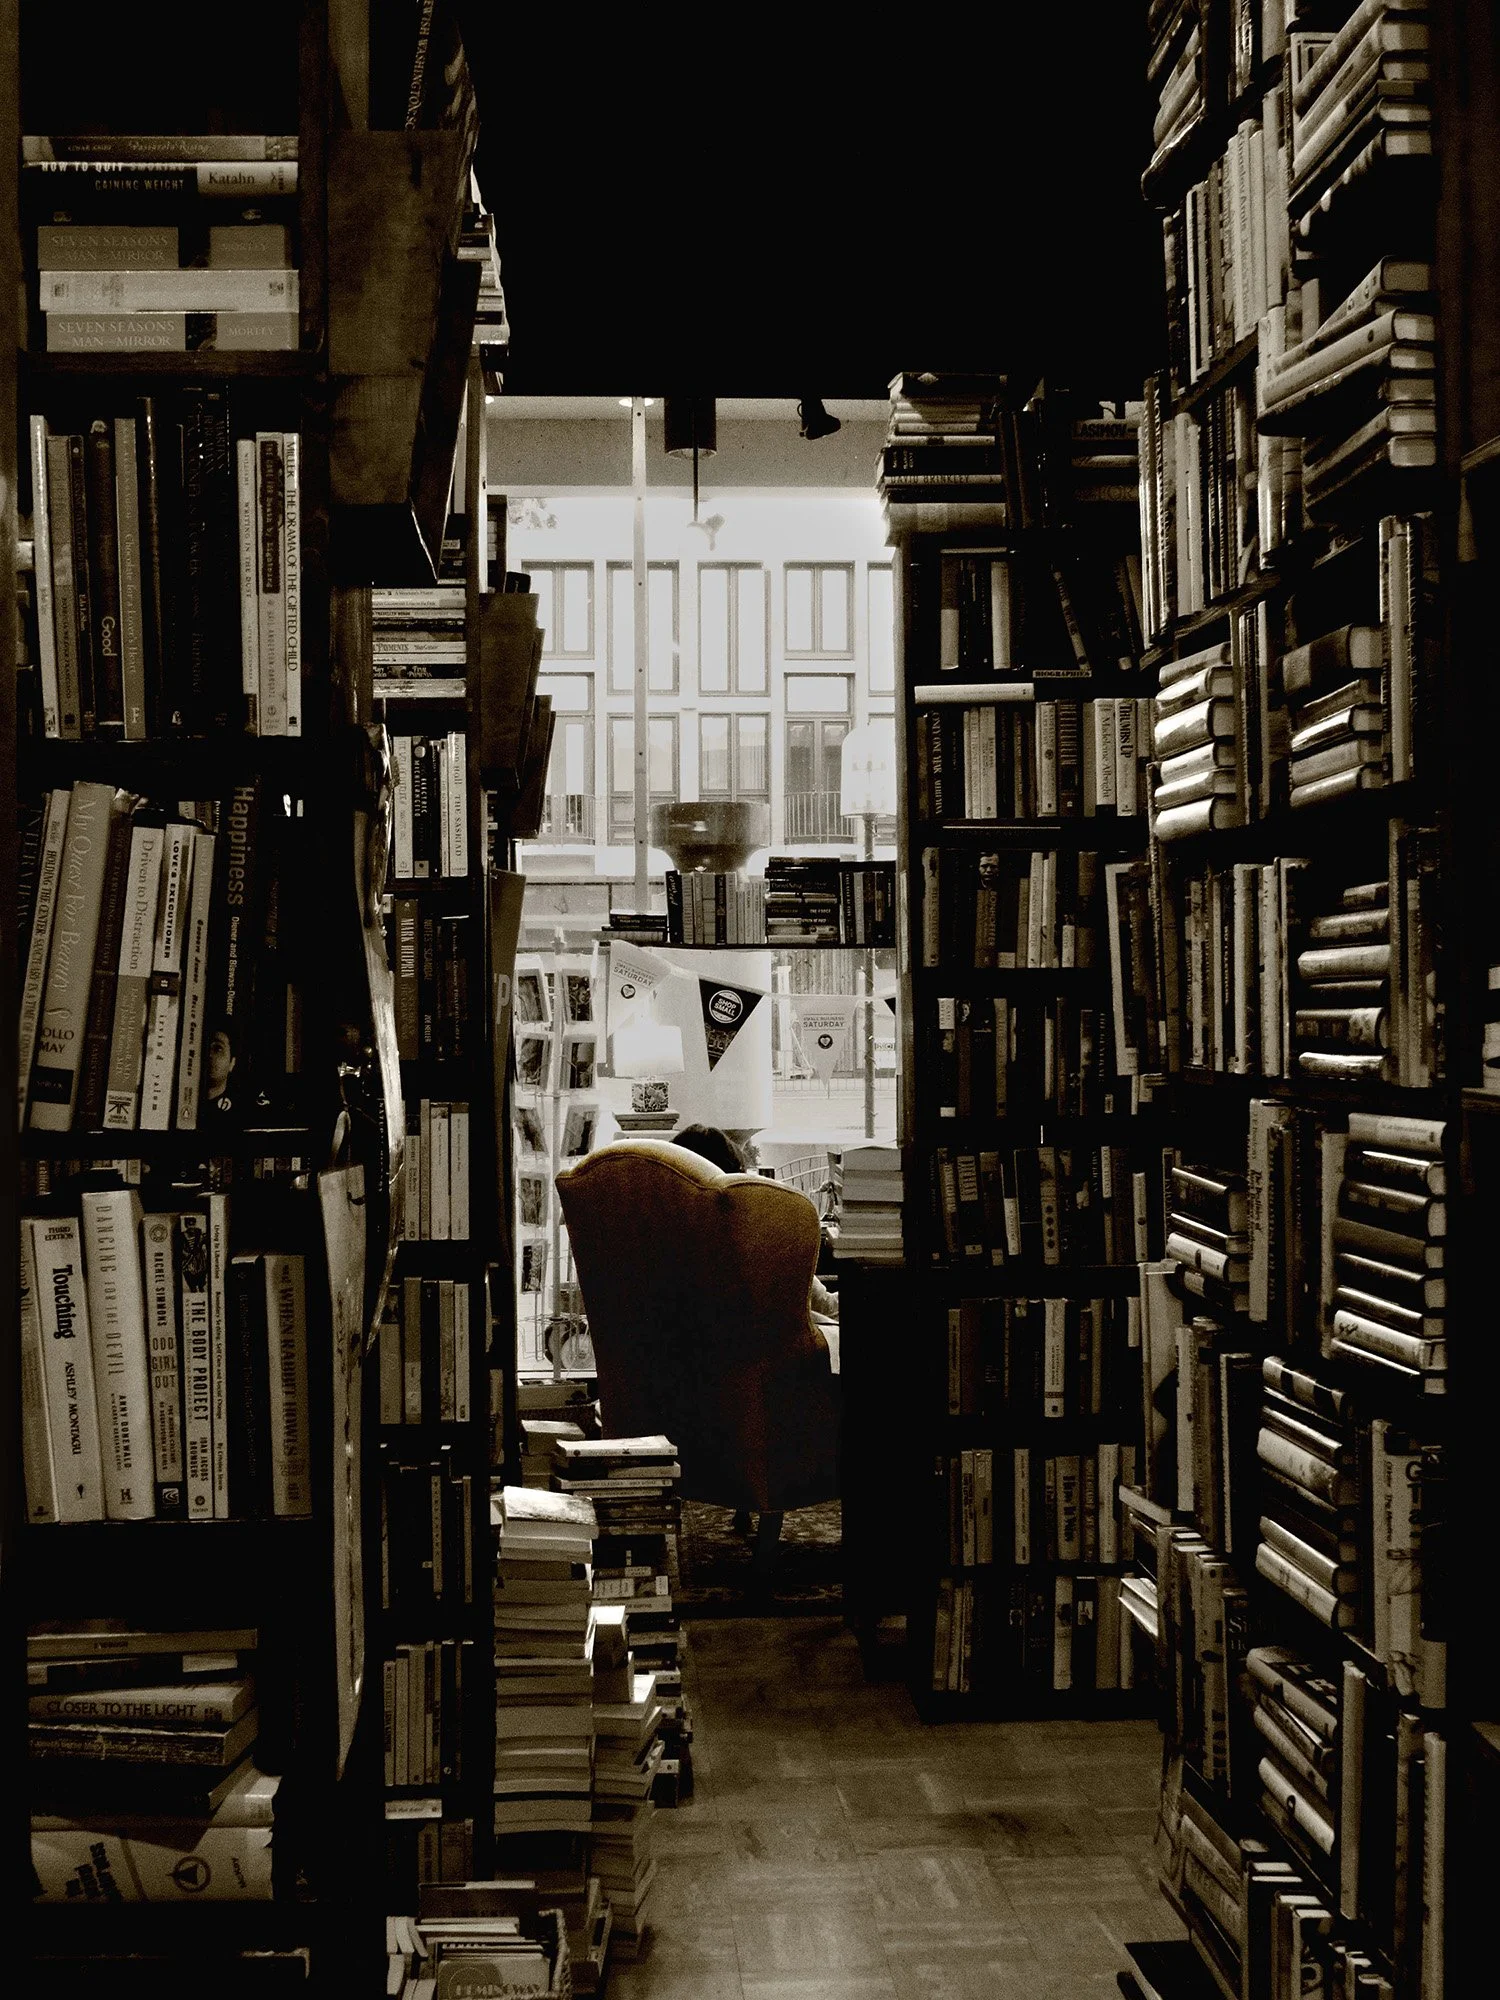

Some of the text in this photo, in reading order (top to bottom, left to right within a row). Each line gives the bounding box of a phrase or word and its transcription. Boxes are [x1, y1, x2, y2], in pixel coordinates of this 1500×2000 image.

[420, 0, 435, 35] EWISH
[96, 163, 123, 173] QUIT
[144, 179, 185, 190] WEIGHT
[208, 172, 255, 186] Katahn
[103, 235, 168, 246] SEASONS
[58, 321, 175, 333] SEVEN SEASONS
[117, 336, 171, 346] MIRROR
[124, 534, 136, 581] Chocolate
[286, 441, 298, 672] MILLER THE DRAMA OF THE GIFTED CHILD
[245, 577, 253, 598] DUST
[100, 616, 118, 657] Good
[128, 647, 140, 676] Heart
[1119, 703, 1133, 743] THUMBS
[1100, 717, 1113, 798] Madeleine Albright
[454, 794, 462, 815] THE
[227, 786, 255, 906] Happiness
[41, 850, 58, 886] HOLDING
[38, 887, 53, 903] THE
[51, 797, 97, 994] My Quest For Beauty
[107, 868, 121, 923] EVERYTHING
[129, 839, 155, 970] Driven to Distraction
[164, 840, 181, 959] LOVE'S EXECUTIONER
[400, 918, 414, 978] MARK HELPRIN
[225, 916, 240, 1016] Diener and Biswas-Diener
[613, 966, 653, 987] SATURDAY
[713, 1002, 736, 1017] SMALL
[717, 998, 737, 1010] SHOP
[41, 1027, 75, 1040] OLLO
[156, 1014, 168, 1048] irvin
[803, 1020, 845, 1028] SATURDAY
[41, 1041, 66, 1053] MAY
[149, 1073, 162, 1112] yalom
[45, 1232, 74, 1241] EDITION
[53, 1265, 77, 1340] Touching
[95, 1206, 124, 1376] DANCING FOR THE DEVIL
[154, 1252, 168, 1327] RACHEL SIMMONS
[279, 1286, 294, 1335] WHEN
[152, 1337, 175, 1351] ODD
[191, 1301, 208, 1421] THE BODY PROJECT
[151, 1356, 177, 1371] GIRL
[280, 1339, 297, 1396] RABBIT
[154, 1374, 176, 1389] OUT
[65, 1361, 82, 1455] ASHLEY MONTAGU
[283, 1402, 299, 1456] HOWLS
[47, 1701, 196, 1718] CLOSER TO THE LIGHT
